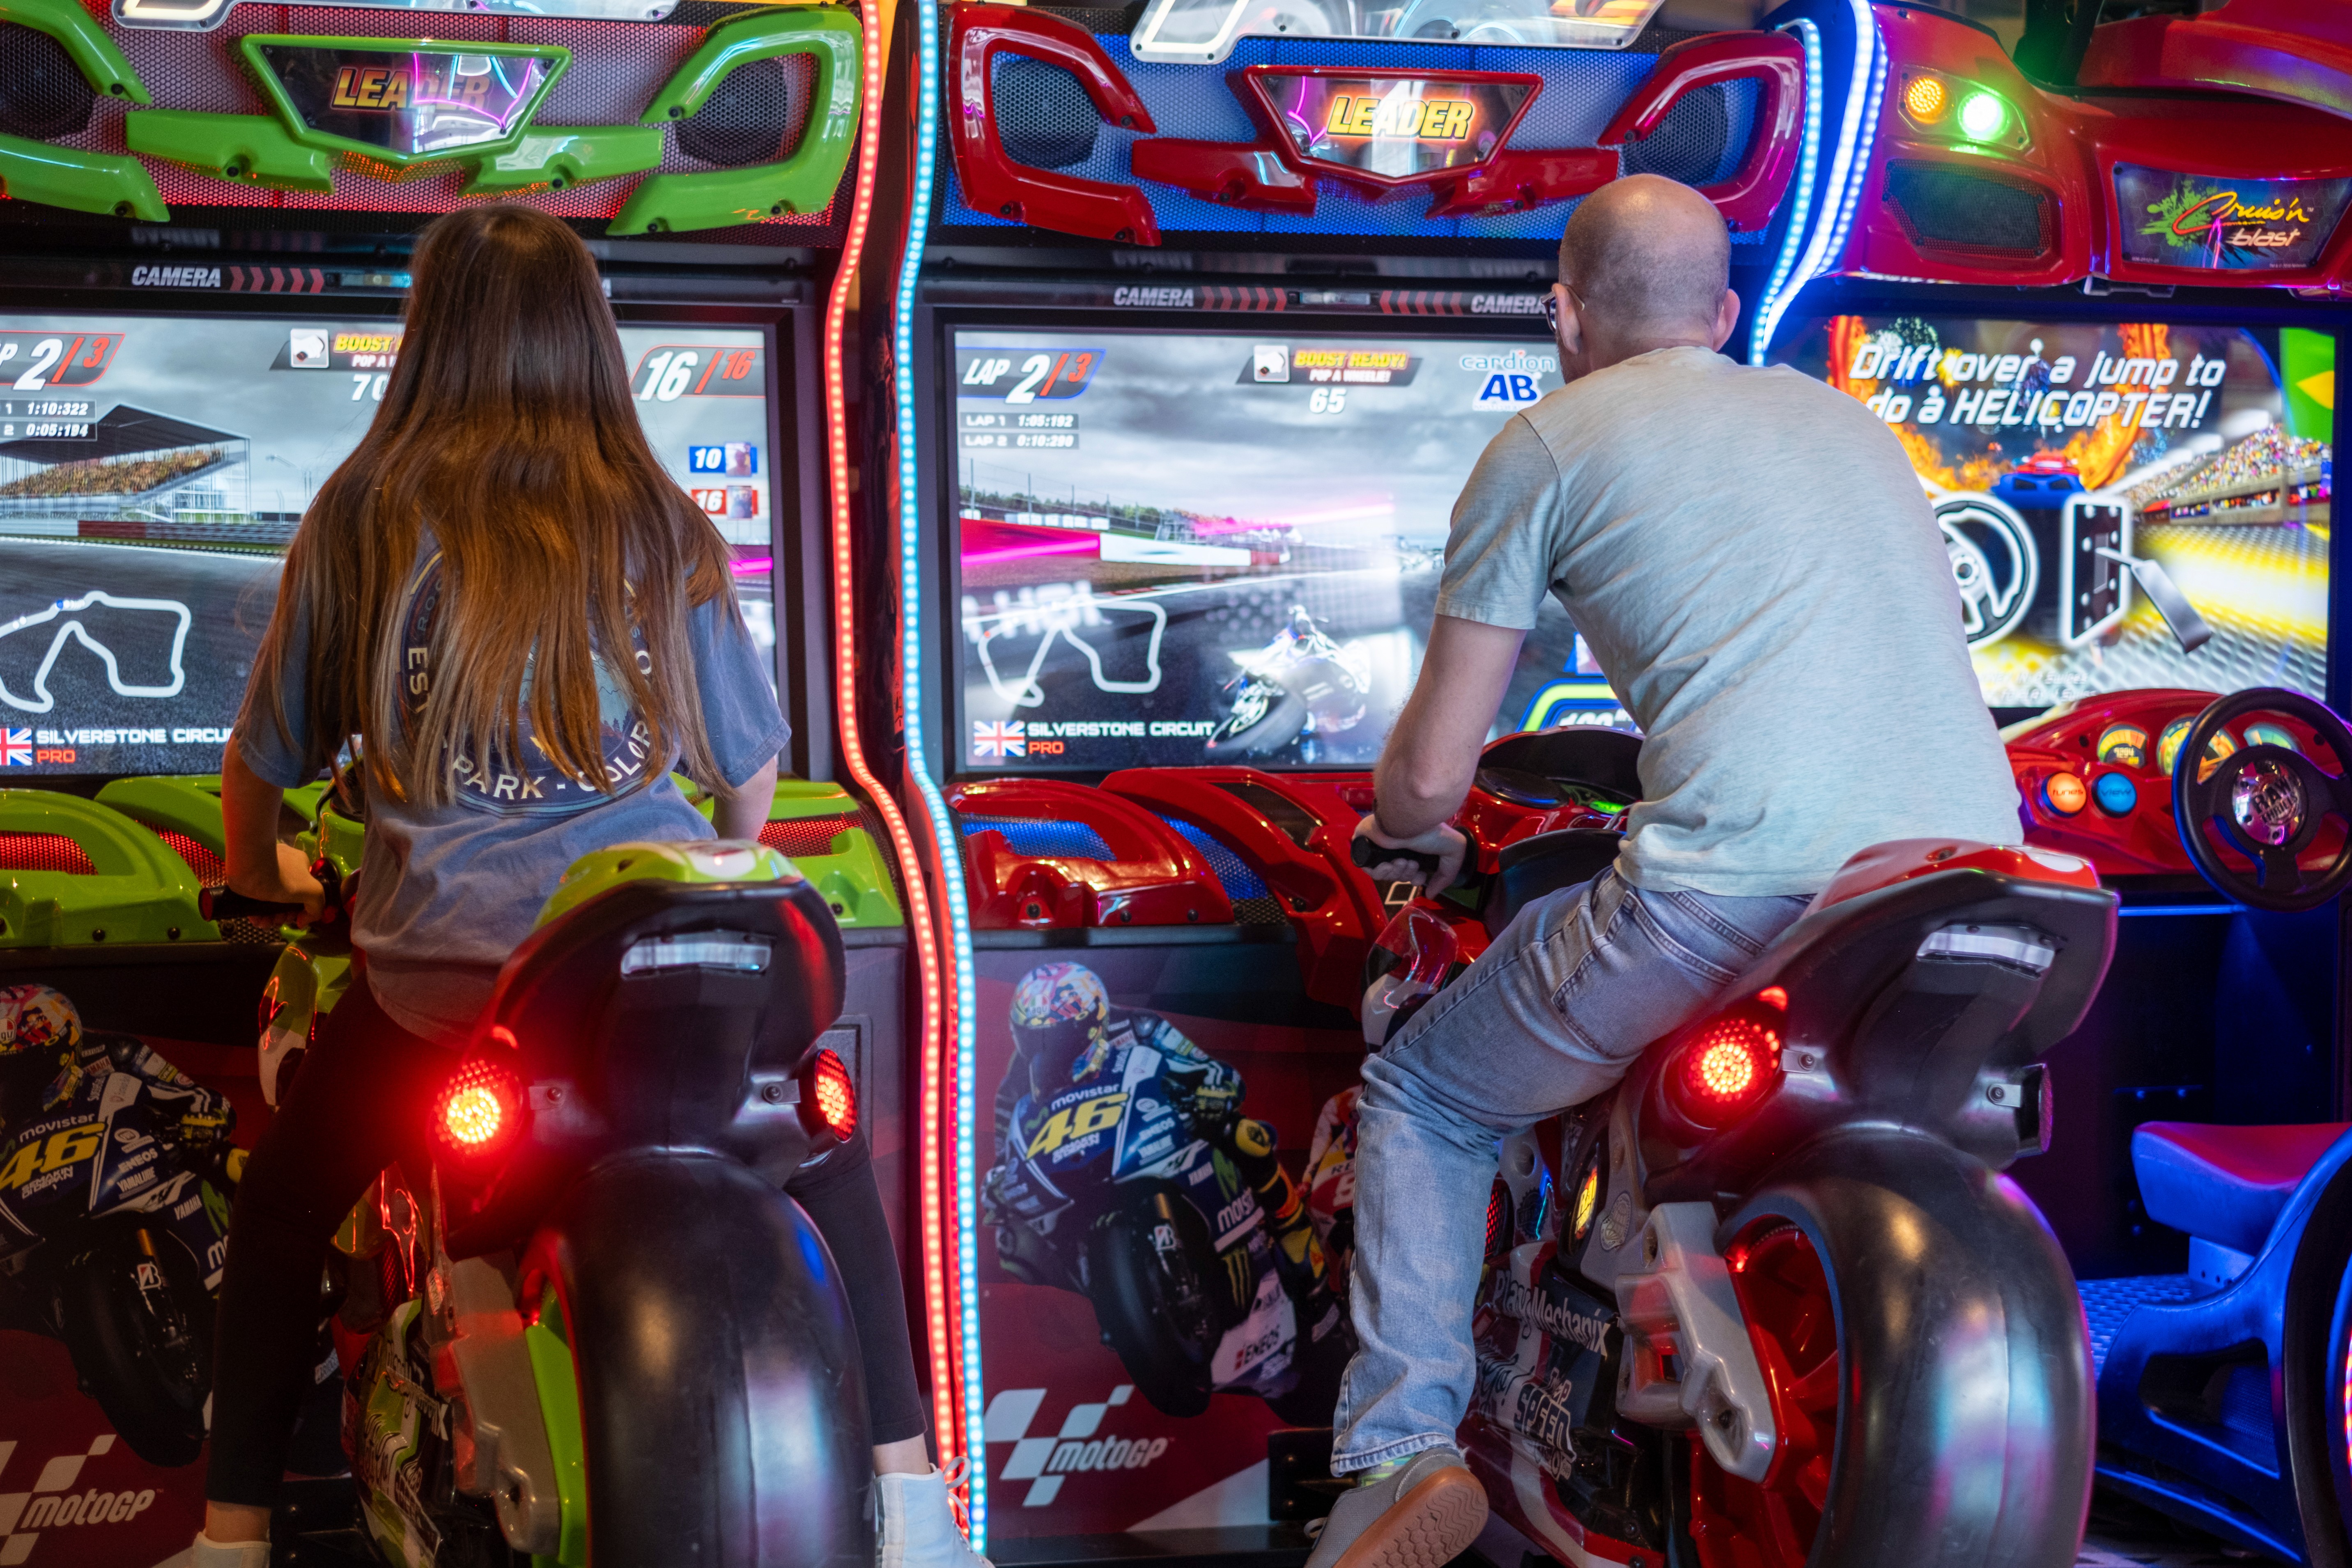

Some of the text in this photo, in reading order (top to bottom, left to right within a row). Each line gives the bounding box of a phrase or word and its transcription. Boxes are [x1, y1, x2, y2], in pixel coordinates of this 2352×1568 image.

[330, 67, 491, 112] LEADER
[1328, 96, 1473, 140] LEADER
[2230, 228, 2300, 246] blast
[131, 266, 221, 287] CAMERA
[1114, 287, 1194, 307] CAMERA
[334, 335, 394, 353] BOOST
[351, 354, 375, 367] POP
[377, 356, 387, 367] A
[1294, 351, 1407, 368] BOOST READY!
[1462, 351, 1554, 370] cardion
[1849, 344, 1942, 380] Drift
[1953, 352, 2040, 383] over
[2049, 356, 2076, 384] a
[2185, 353, 2227, 387] to
[962, 358, 1011, 385] LAP
[1480, 374, 1537, 401] AB
[5, 402, 89, 416] 1 1:10:322
[1309, 387, 1346, 414] 65
[1867, 388, 1913, 424] do
[1949, 389, 2212, 429] HELICOPTER!
[4, 424, 14, 436] 2
[966, 414, 996, 427] LAP
[998, 414, 1006, 427] 1
[965, 435, 994, 446] LAP
[997, 435, 1008, 447] 2
[695, 448, 723, 469] 10
[696, 490, 724, 512] 16
[36, 728, 234, 744] SILVERSTONE CIRCUI
[1027, 721, 1216, 737] SILVERSTONE CIRCUIT
[37, 749, 76, 764] PRO
[1028, 741, 1065, 754] PRO
[2100, 787, 2132, 796] view
[1051, 1084, 1120, 1111] movistar
[19, 1113, 95, 1143] movistar
[1027, 1092, 1130, 1159] 46
[0, 1122, 106, 1190] 46
[117, 1147, 158, 1174] ENEOS
[173, 1194, 203, 1221] YAMAHA
